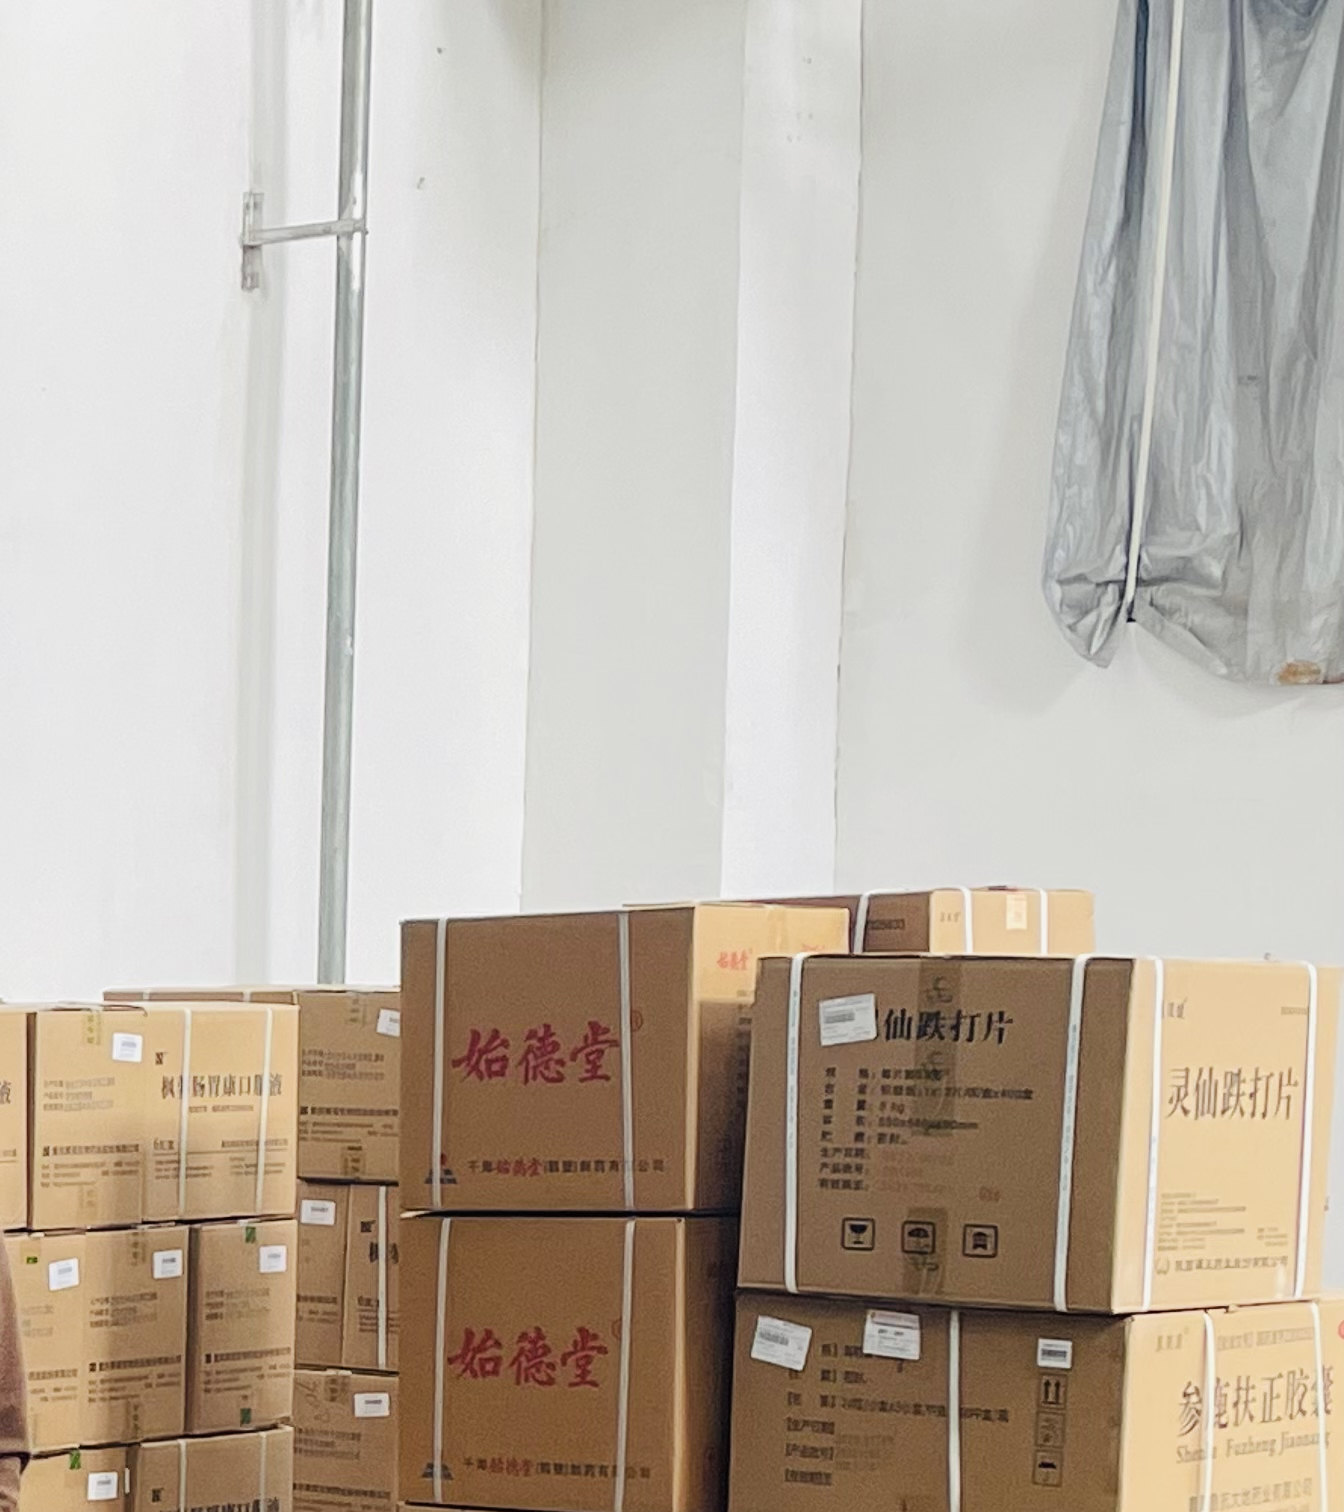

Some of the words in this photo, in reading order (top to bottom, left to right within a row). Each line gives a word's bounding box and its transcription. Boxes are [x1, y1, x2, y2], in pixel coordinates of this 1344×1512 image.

[452, 1020, 620, 1086] 始德堂
[875, 1008, 1013, 1045] 仙跌打片
[1166, 1066, 1299, 1121] 灵仙跌打片
[447, 1326, 609, 1388] 始德堂
